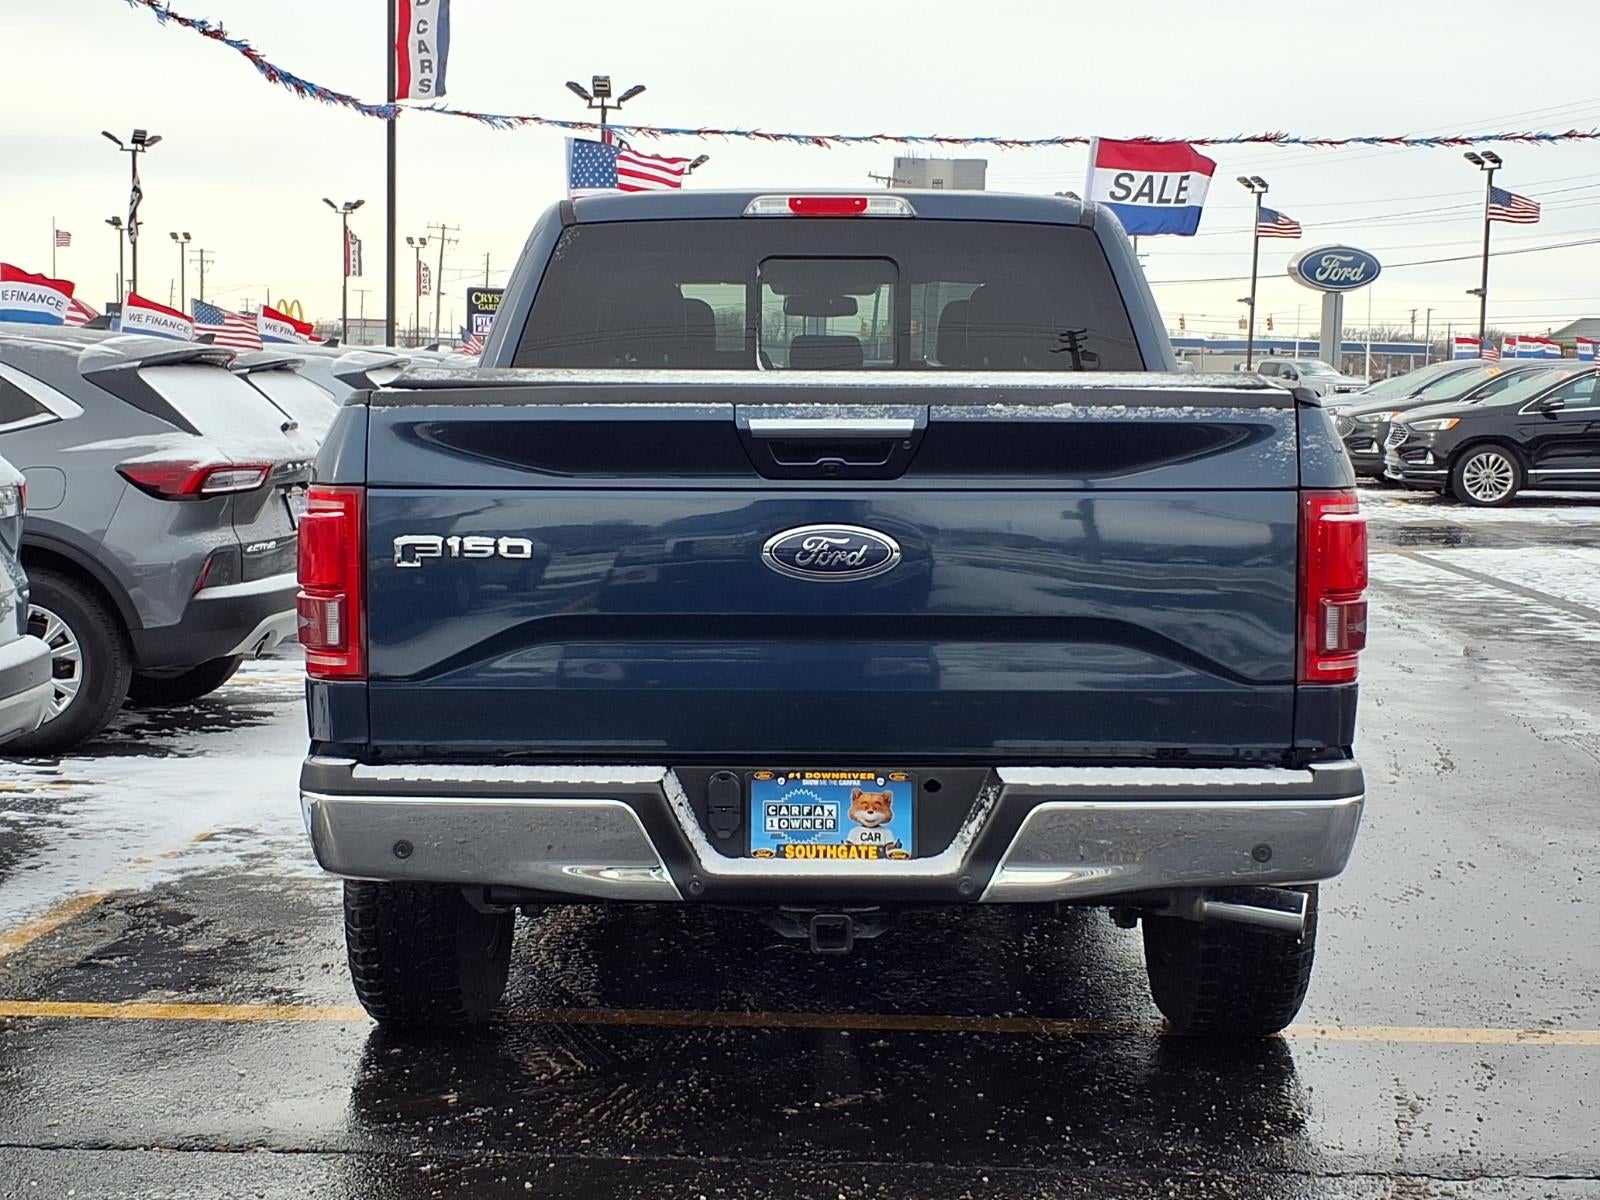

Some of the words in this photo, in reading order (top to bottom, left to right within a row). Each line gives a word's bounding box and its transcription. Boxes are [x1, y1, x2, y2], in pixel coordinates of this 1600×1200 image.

[417, 19, 433, 93] CARS
[1109, 172, 1191, 204] SALE
[1315, 254, 1366, 281] Ford
[10, 289, 64, 312] FINANCE
[128, 312, 143, 323] WE
[145, 315, 190, 334] FINANCE
[264, 322, 278, 333] WE
[795, 536, 868, 566] Ford
[788, 772, 801, 780] #1
[805, 772, 875, 780] DOWNRIVER
[768, 805, 834, 817] CARFAX
[860, 832, 881, 842] CAR
[785, 845, 878, 859] SOUTHGATE
